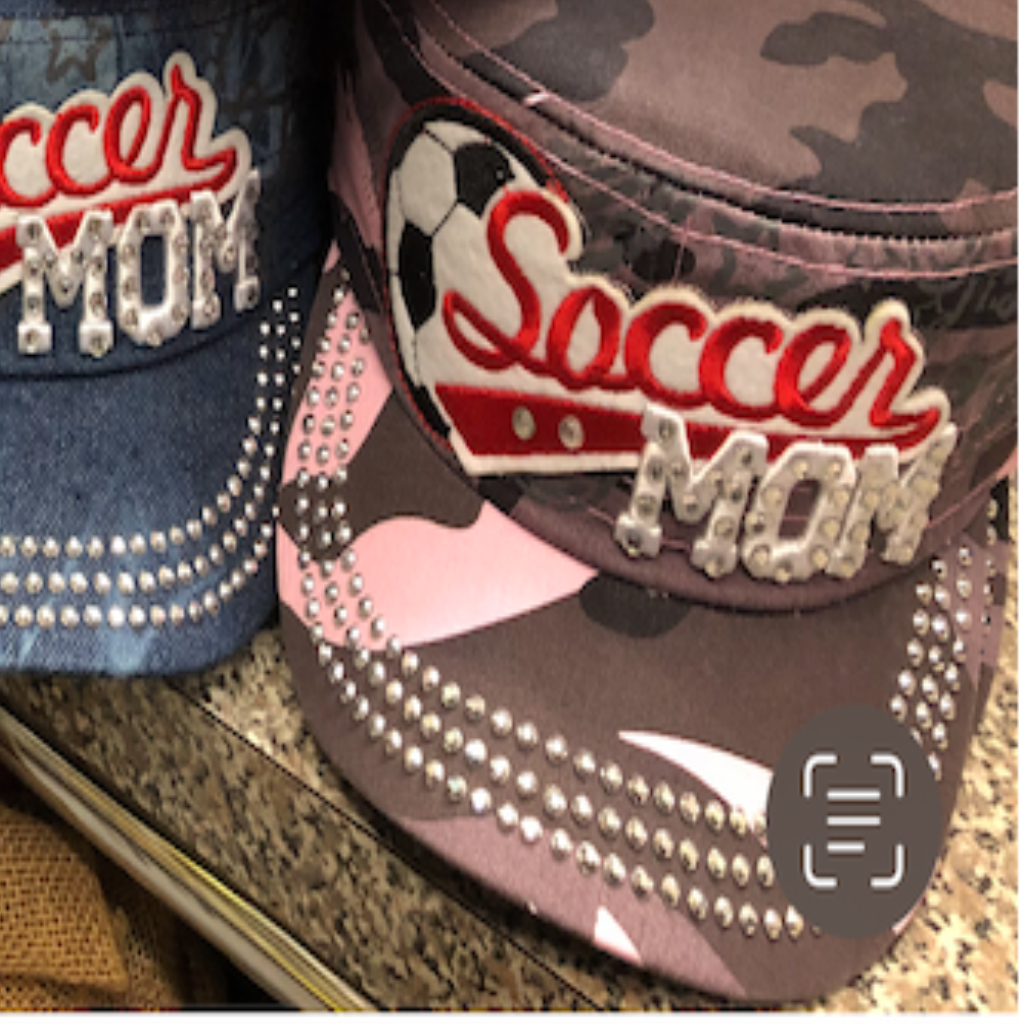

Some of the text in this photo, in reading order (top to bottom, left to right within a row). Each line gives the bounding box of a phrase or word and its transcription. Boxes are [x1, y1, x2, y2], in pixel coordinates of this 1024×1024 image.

[16, 170, 261, 356] MOM
[442, 189, 940, 431] Soccer
[614, 404, 959, 582] MOM
